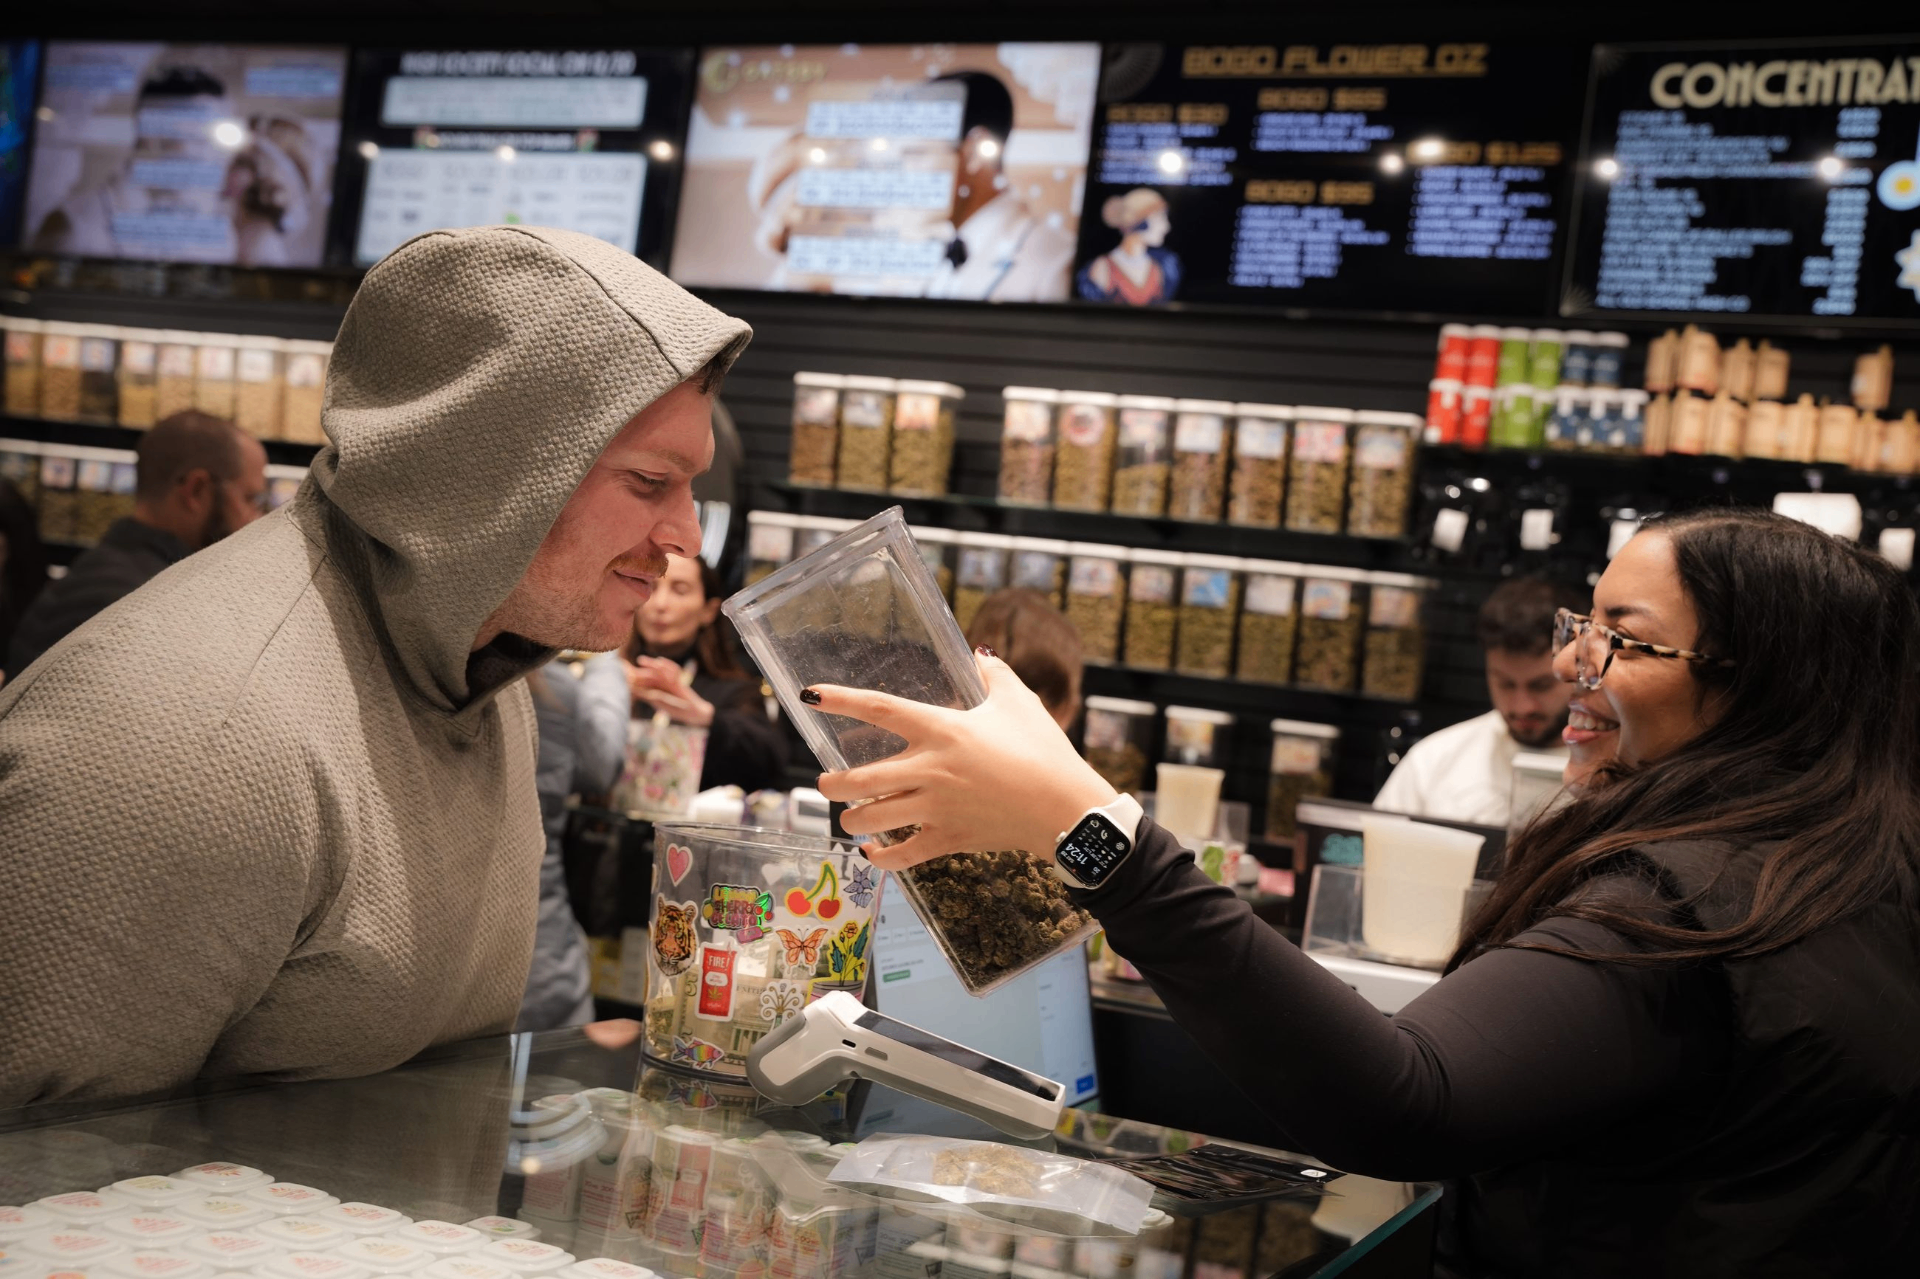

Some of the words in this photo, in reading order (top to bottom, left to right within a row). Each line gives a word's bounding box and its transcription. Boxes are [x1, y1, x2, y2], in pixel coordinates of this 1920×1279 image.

[1182, 45, 1277, 74] BOGO
[1281, 44, 1430, 74] FLOWER
[1434, 43, 1488, 73] OZ
[1650, 57, 1920, 108] CONCENTRAT
[1065, 842, 1088, 865] 11:24
[708, 955, 730, 969] FIRE!
